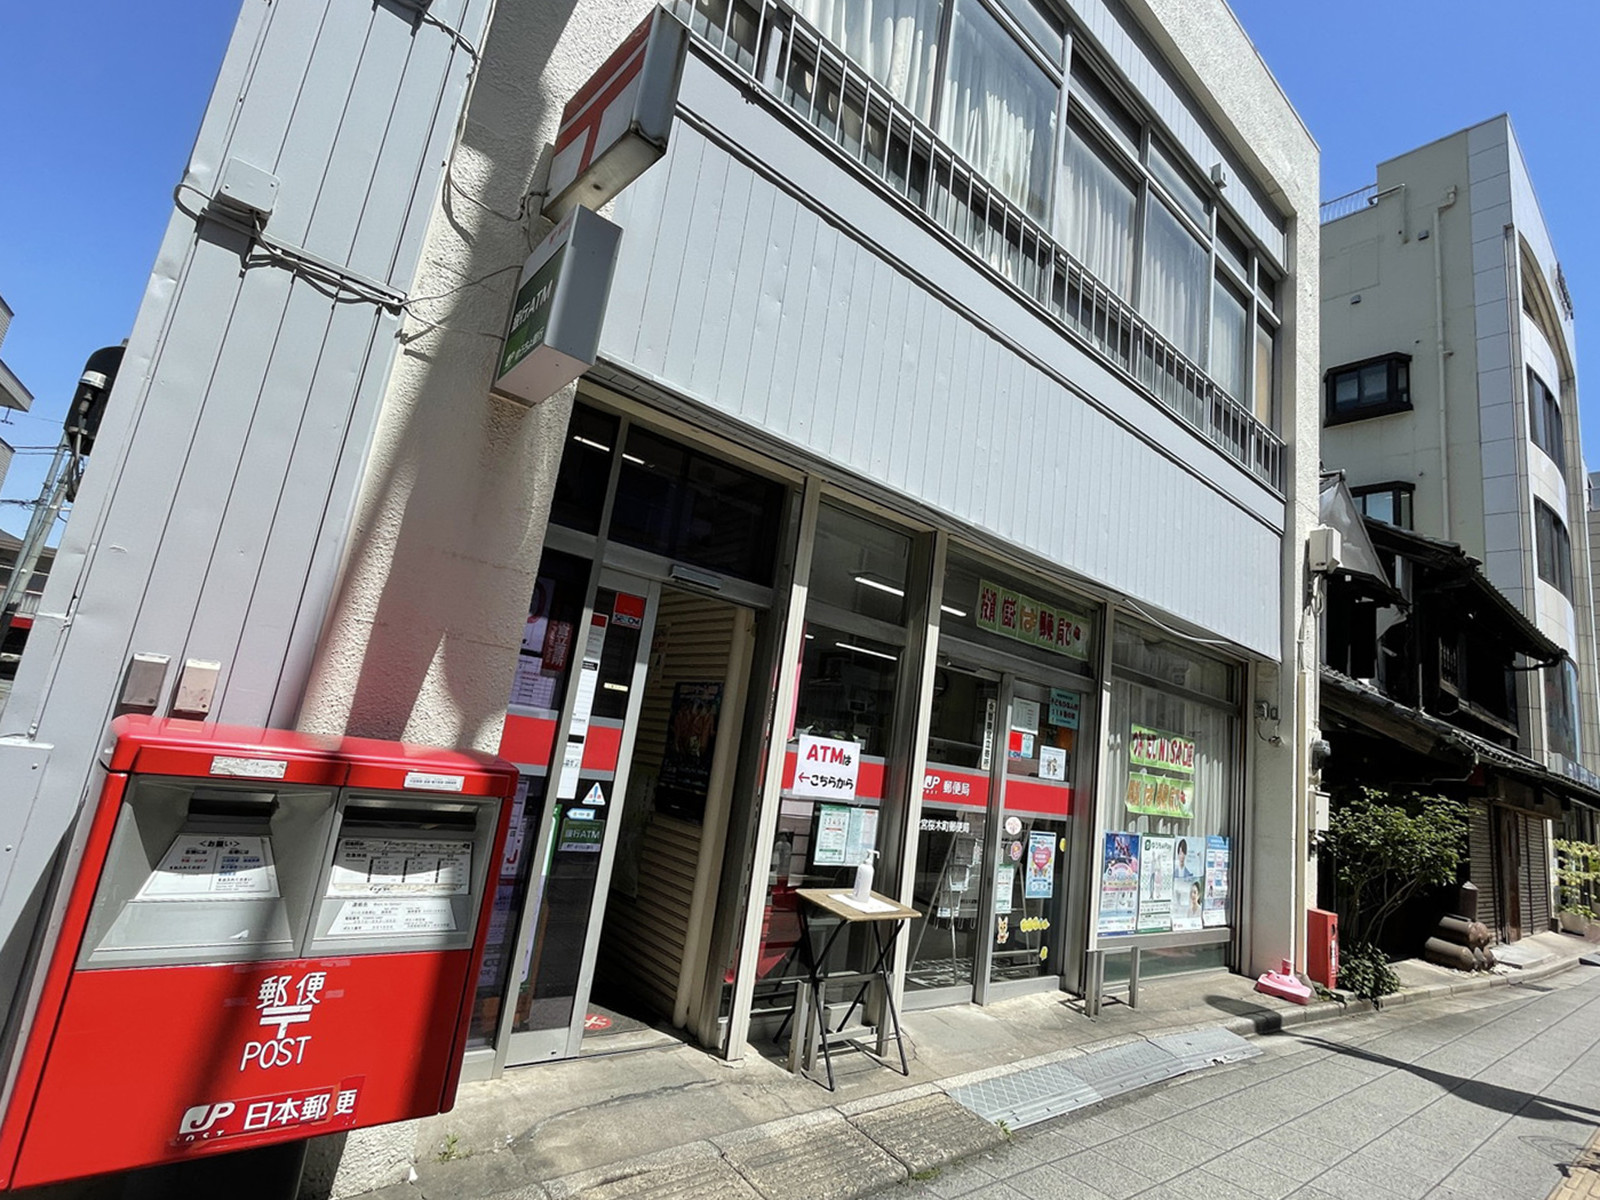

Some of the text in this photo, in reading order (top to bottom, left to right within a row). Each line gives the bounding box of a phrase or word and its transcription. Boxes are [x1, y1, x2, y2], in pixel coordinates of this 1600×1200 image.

[807, 744, 852, 766] ATMは
[810, 774, 854, 790] こちらから
[943, 780, 970, 797] 郵便局
[256, 972, 327, 1009] 郵便
[239, 1036, 312, 1071] POST
